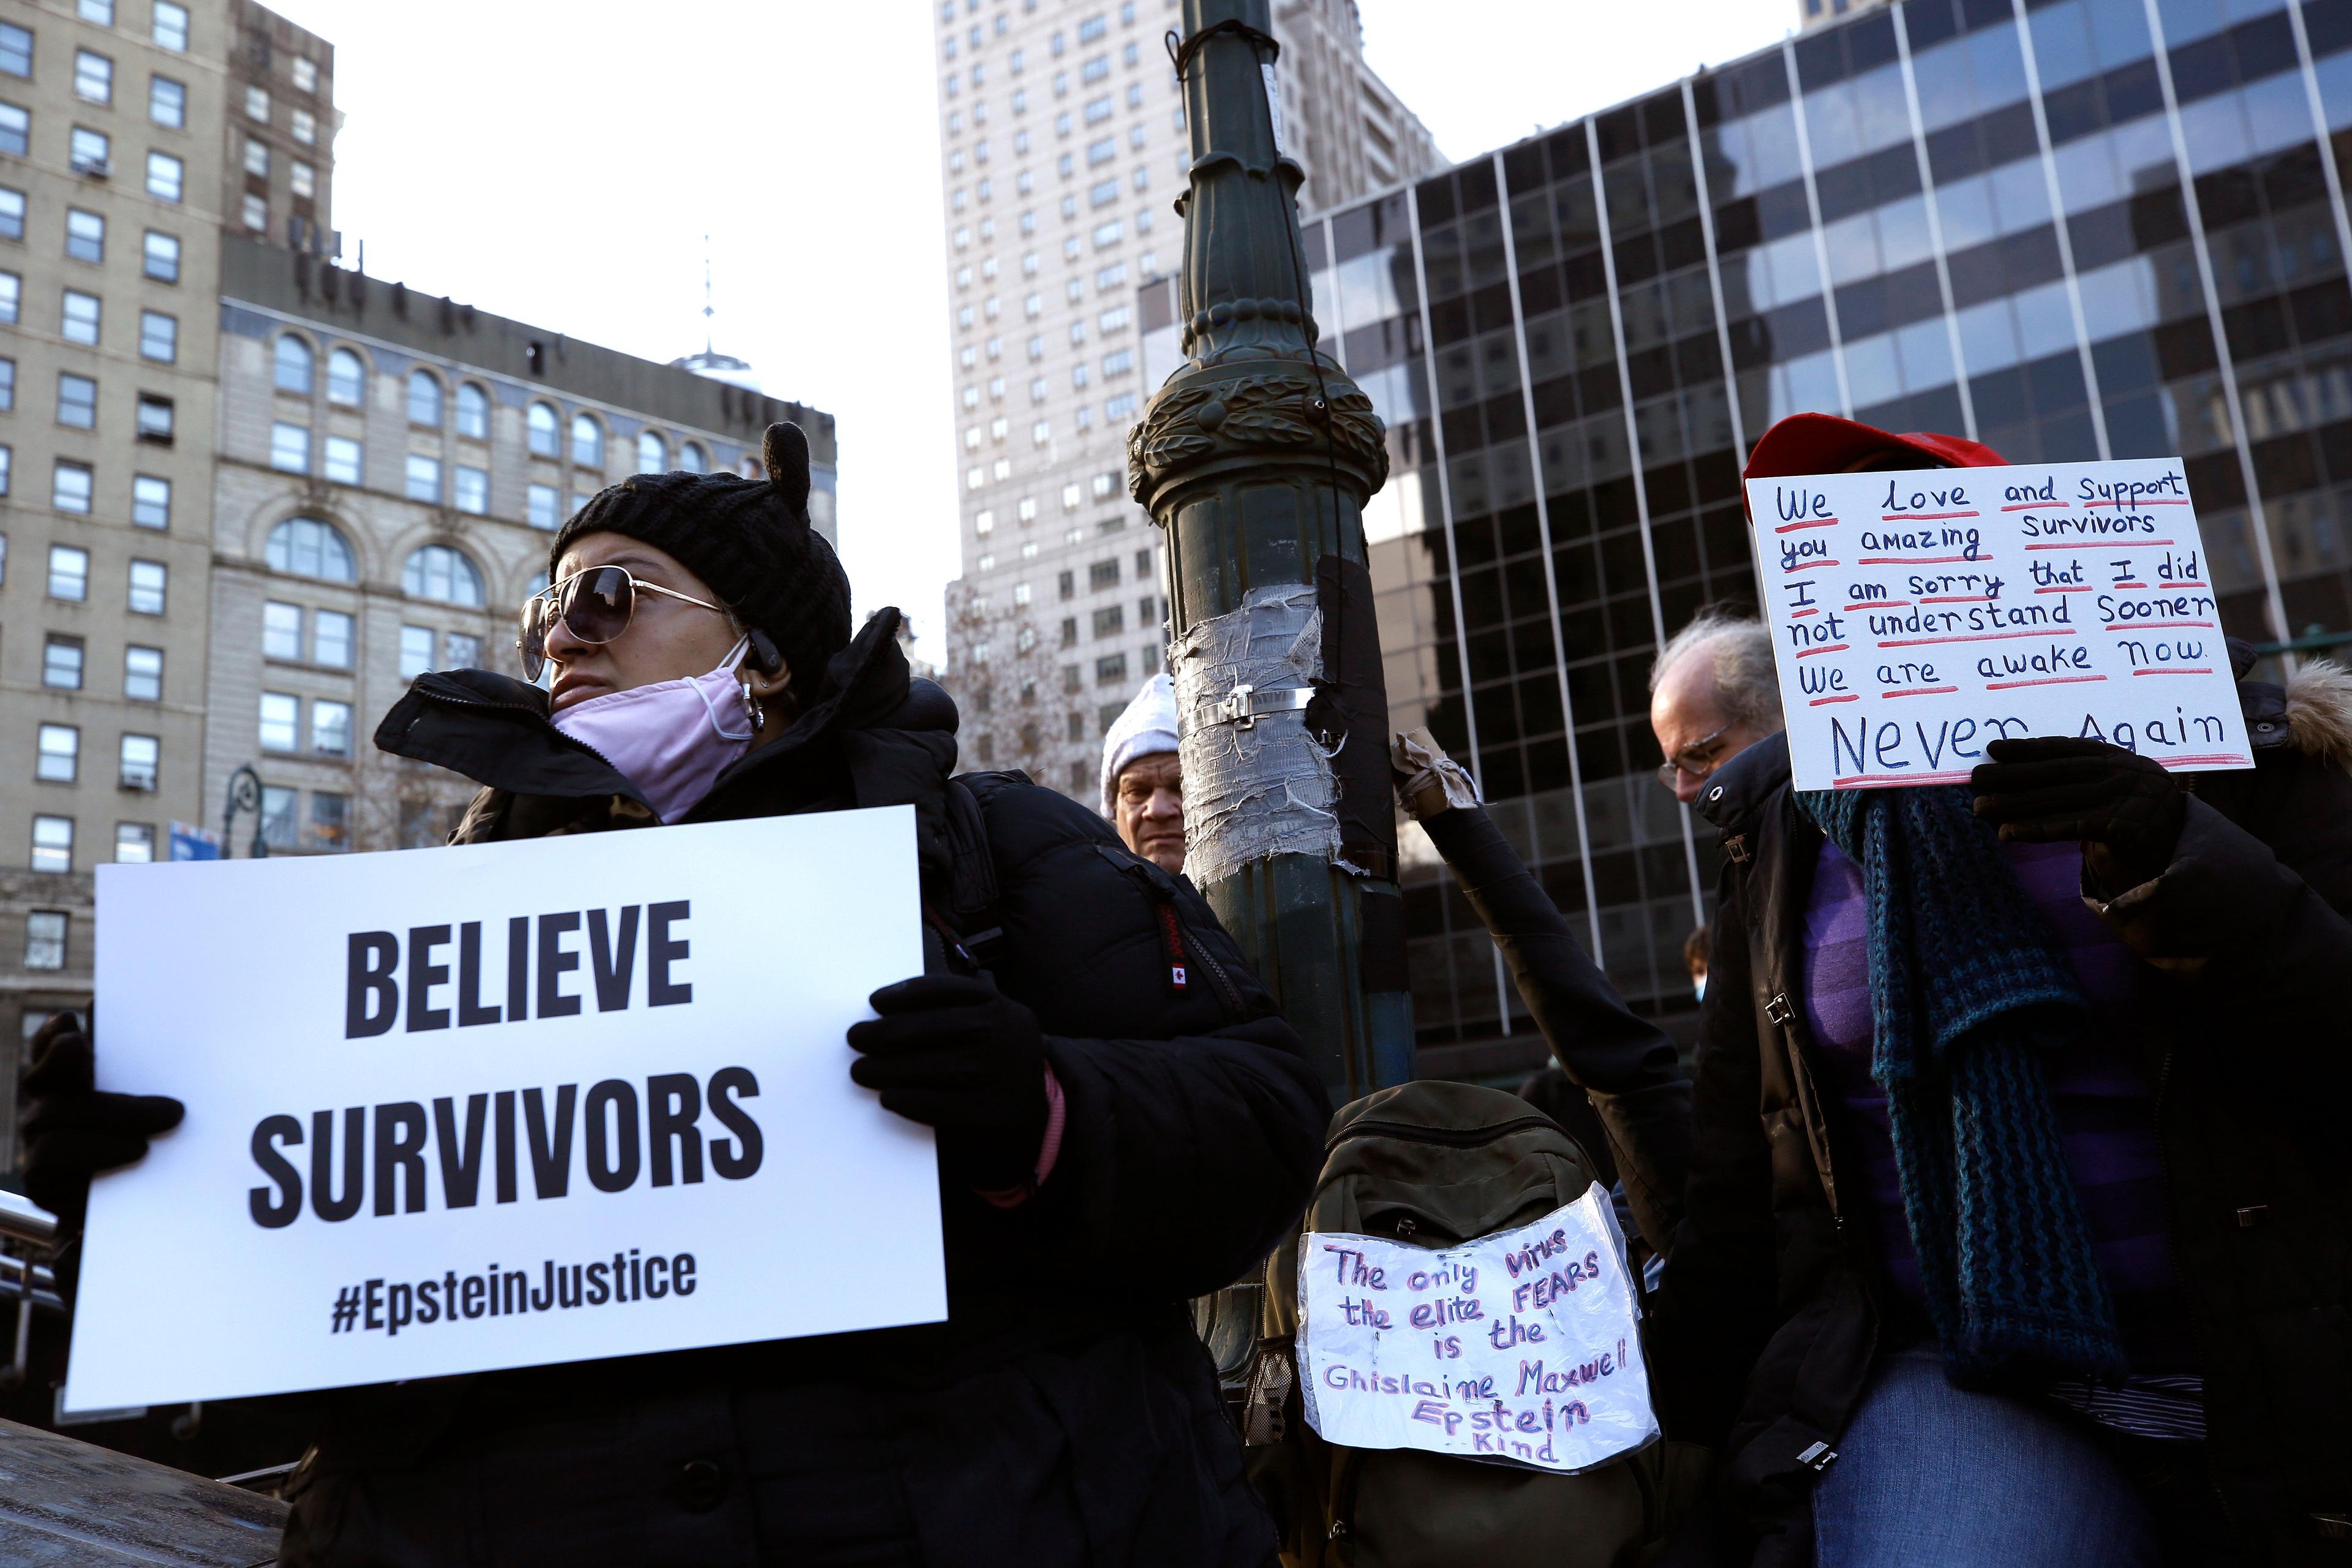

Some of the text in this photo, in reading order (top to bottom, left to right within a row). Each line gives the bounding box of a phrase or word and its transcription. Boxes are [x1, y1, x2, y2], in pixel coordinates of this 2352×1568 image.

[1776, 486, 1833, 521] We
[2004, 475, 2058, 502] and
[1781, 538, 1828, 571] you
[1860, 522, 1981, 562] amazing
[1784, 580, 1816, 607] I
[1847, 582, 1887, 600] am
[2029, 559, 2084, 586] that
[2109, 559, 2136, 582] I
[2157, 551, 2198, 581] did
[1787, 612, 1846, 646] not
[1869, 594, 2073, 636] understand
[1876, 662, 1940, 684] are
[1977, 644, 2092, 678] awake
[1831, 706, 2225, 776] Never Again
[345, 900, 693, 1039] BELIEVE
[249, 1066, 764, 1229] SURVIVORS
[331, 1248, 697, 1336] #EpsteinJustice
[1322, 1244, 1388, 1292] The
[1407, 1263, 1479, 1294] only
[1337, 1250, 1599, 1330] the elite FEARS
[1433, 1314, 1548, 1360] is the
[1323, 1338, 1626, 1401] Ghislaine Maxwell
[1411, 1397, 1591, 1436] Epstein
